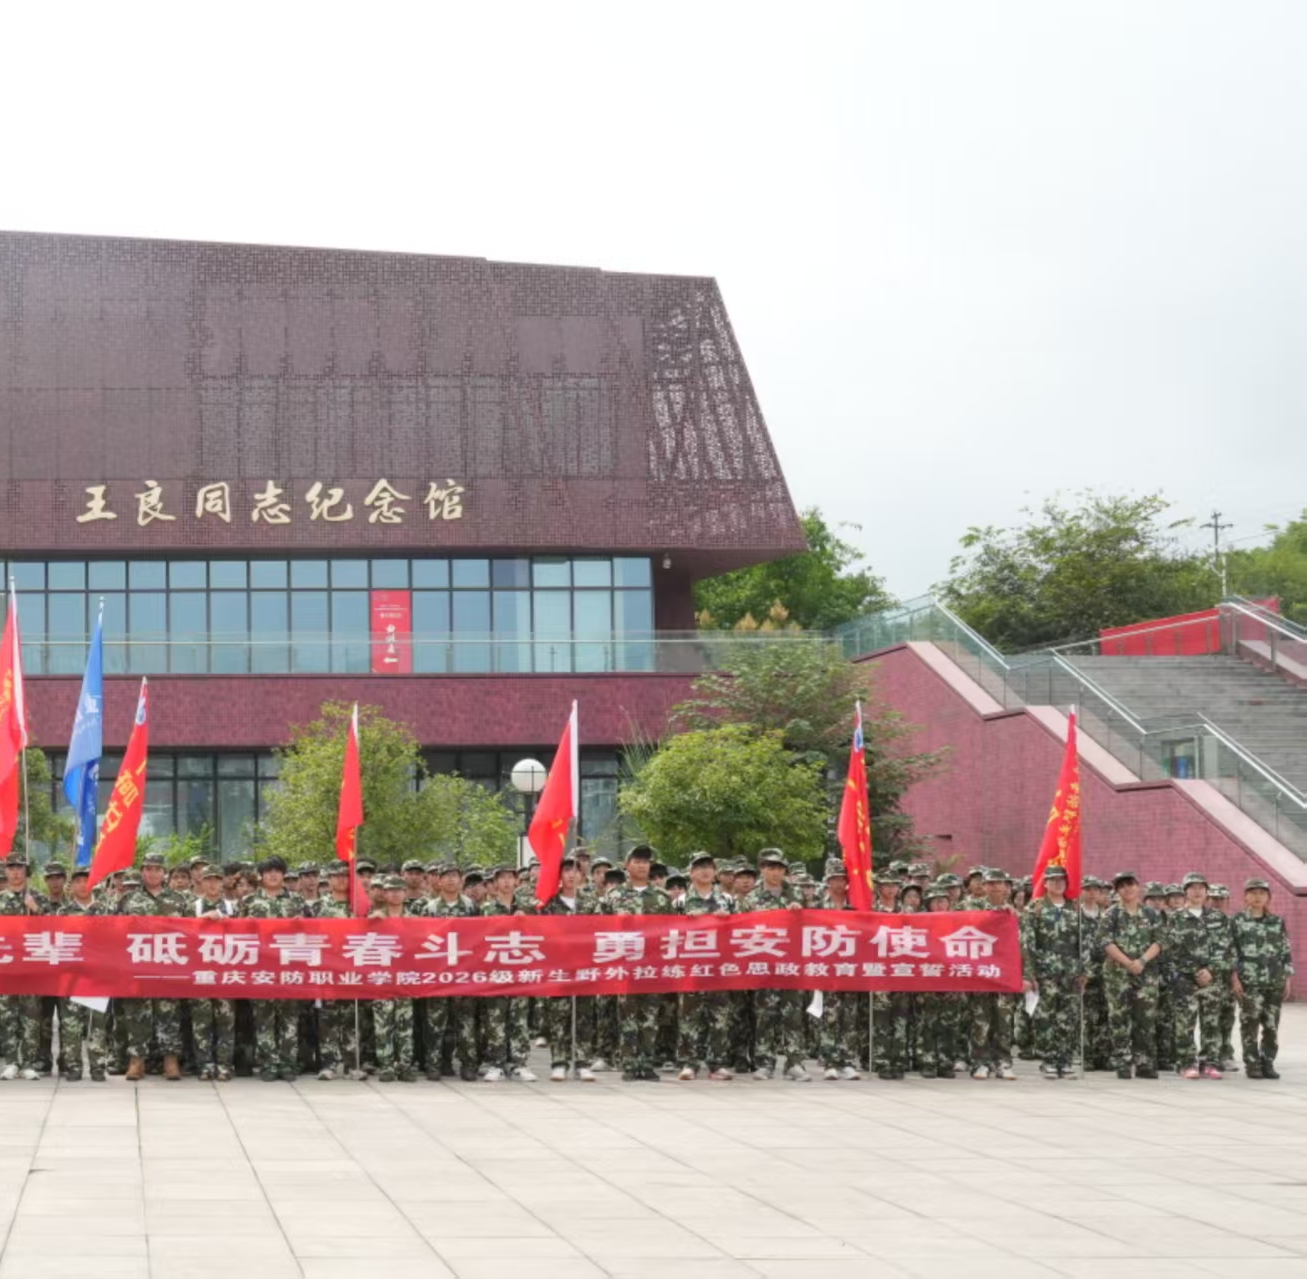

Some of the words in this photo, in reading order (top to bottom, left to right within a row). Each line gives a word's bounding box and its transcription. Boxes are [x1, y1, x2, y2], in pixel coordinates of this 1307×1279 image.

[76, 478, 465, 526] 王良同志纪念馆
[126, 931, 546, 966] 砥砺青春斗志
[593, 925, 997, 962] 勇担安防使命
